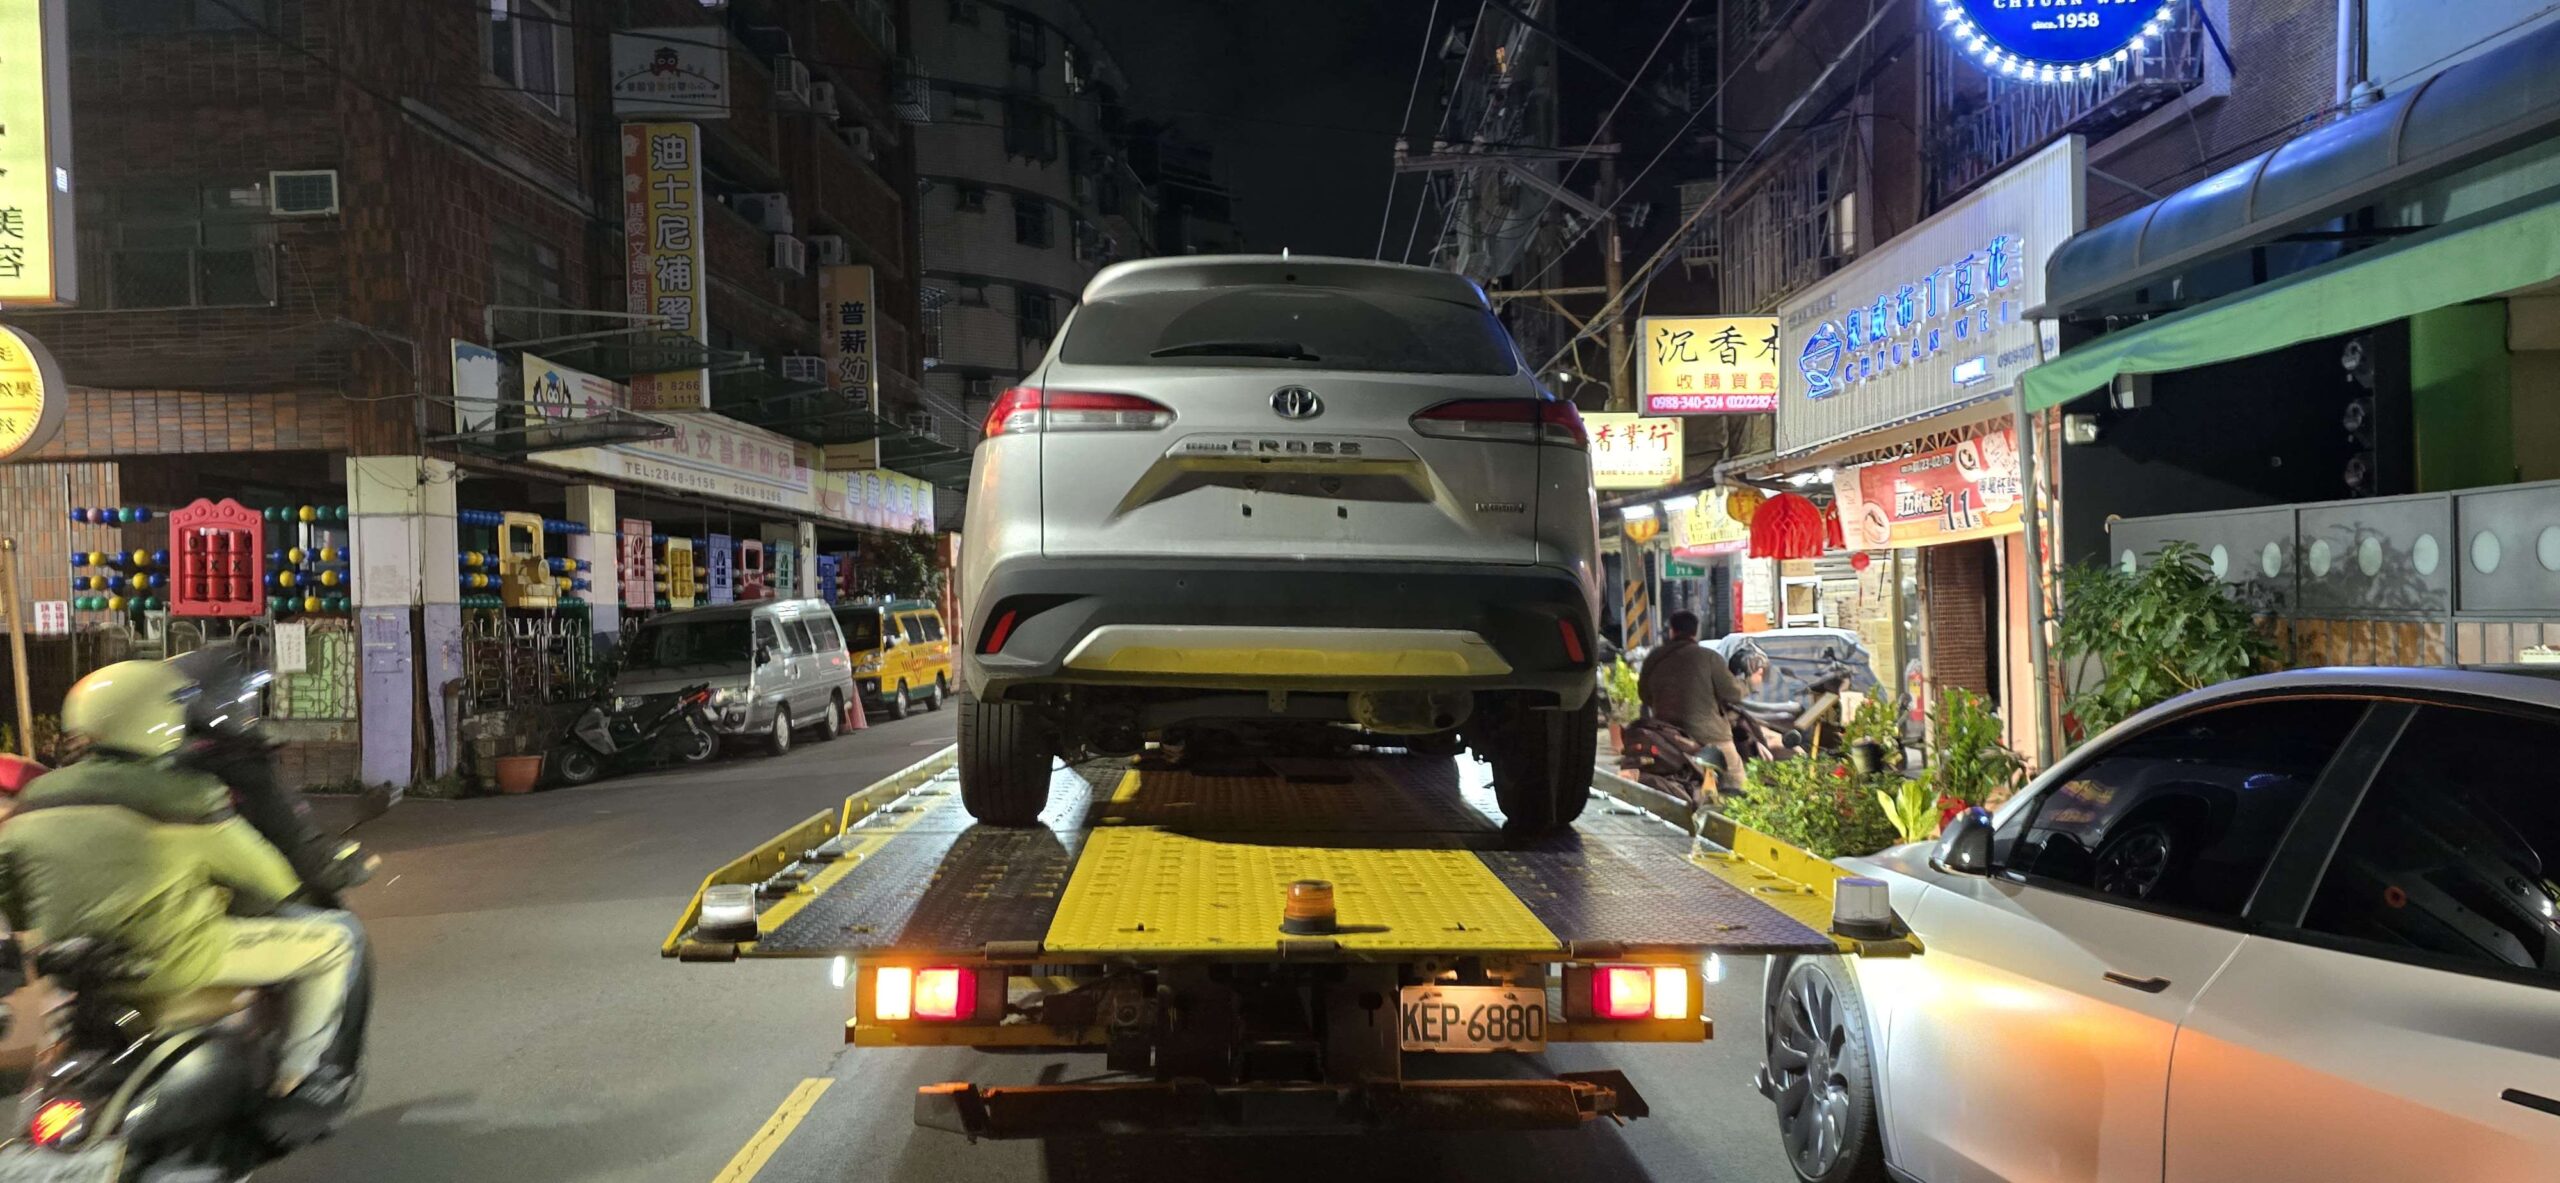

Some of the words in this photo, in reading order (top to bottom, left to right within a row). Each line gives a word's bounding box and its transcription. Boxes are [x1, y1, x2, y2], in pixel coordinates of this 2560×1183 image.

[839, 300, 869, 440] 普薪幼兒
[1402, 1003, 1543, 1042] KEP-6880
